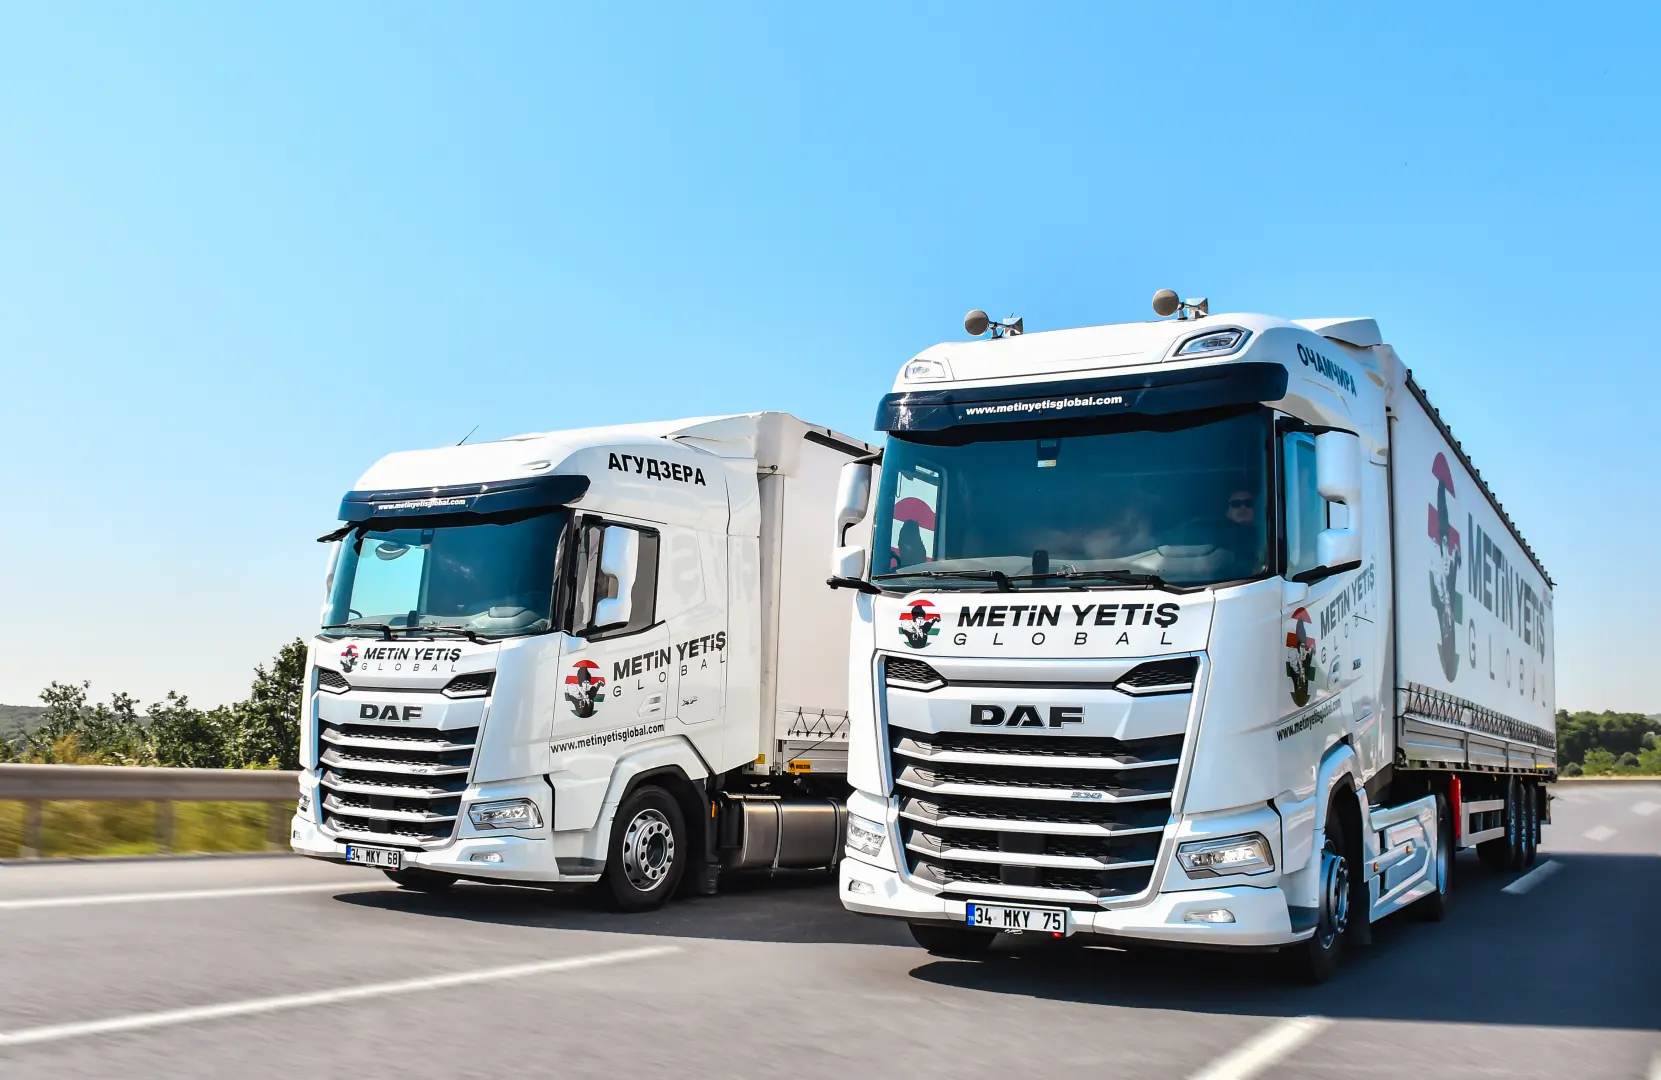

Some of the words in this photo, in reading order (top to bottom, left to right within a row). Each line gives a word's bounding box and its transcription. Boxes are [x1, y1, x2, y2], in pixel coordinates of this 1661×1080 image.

[965, 396, 1123, 416] www.metinyetisglobal.com
[608, 452, 706, 487] АГУДЗЕРА
[378, 499, 466, 510] www.metinyetisglobal.com
[953, 632, 1173, 646] GLOBAL
[1320, 594, 1376, 664] GLOBA
[361, 663, 457, 673] GLOBAL
[612, 653, 726, 698] GLOBAL
[359, 703, 424, 723] DAF
[970, 704, 1085, 729] DAF
[1276, 697, 1341, 741] www.metinyetisglobal.com
[550, 722, 665, 754] www.metinyetisglobal.com
[351, 848, 360, 861] 34
[366, 850, 381, 864] MKY
[387, 852, 398, 865] 68
[975, 907, 992, 925] 34
[1003, 909, 1030, 929] MKY
[1043, 912, 1061, 931] 75
